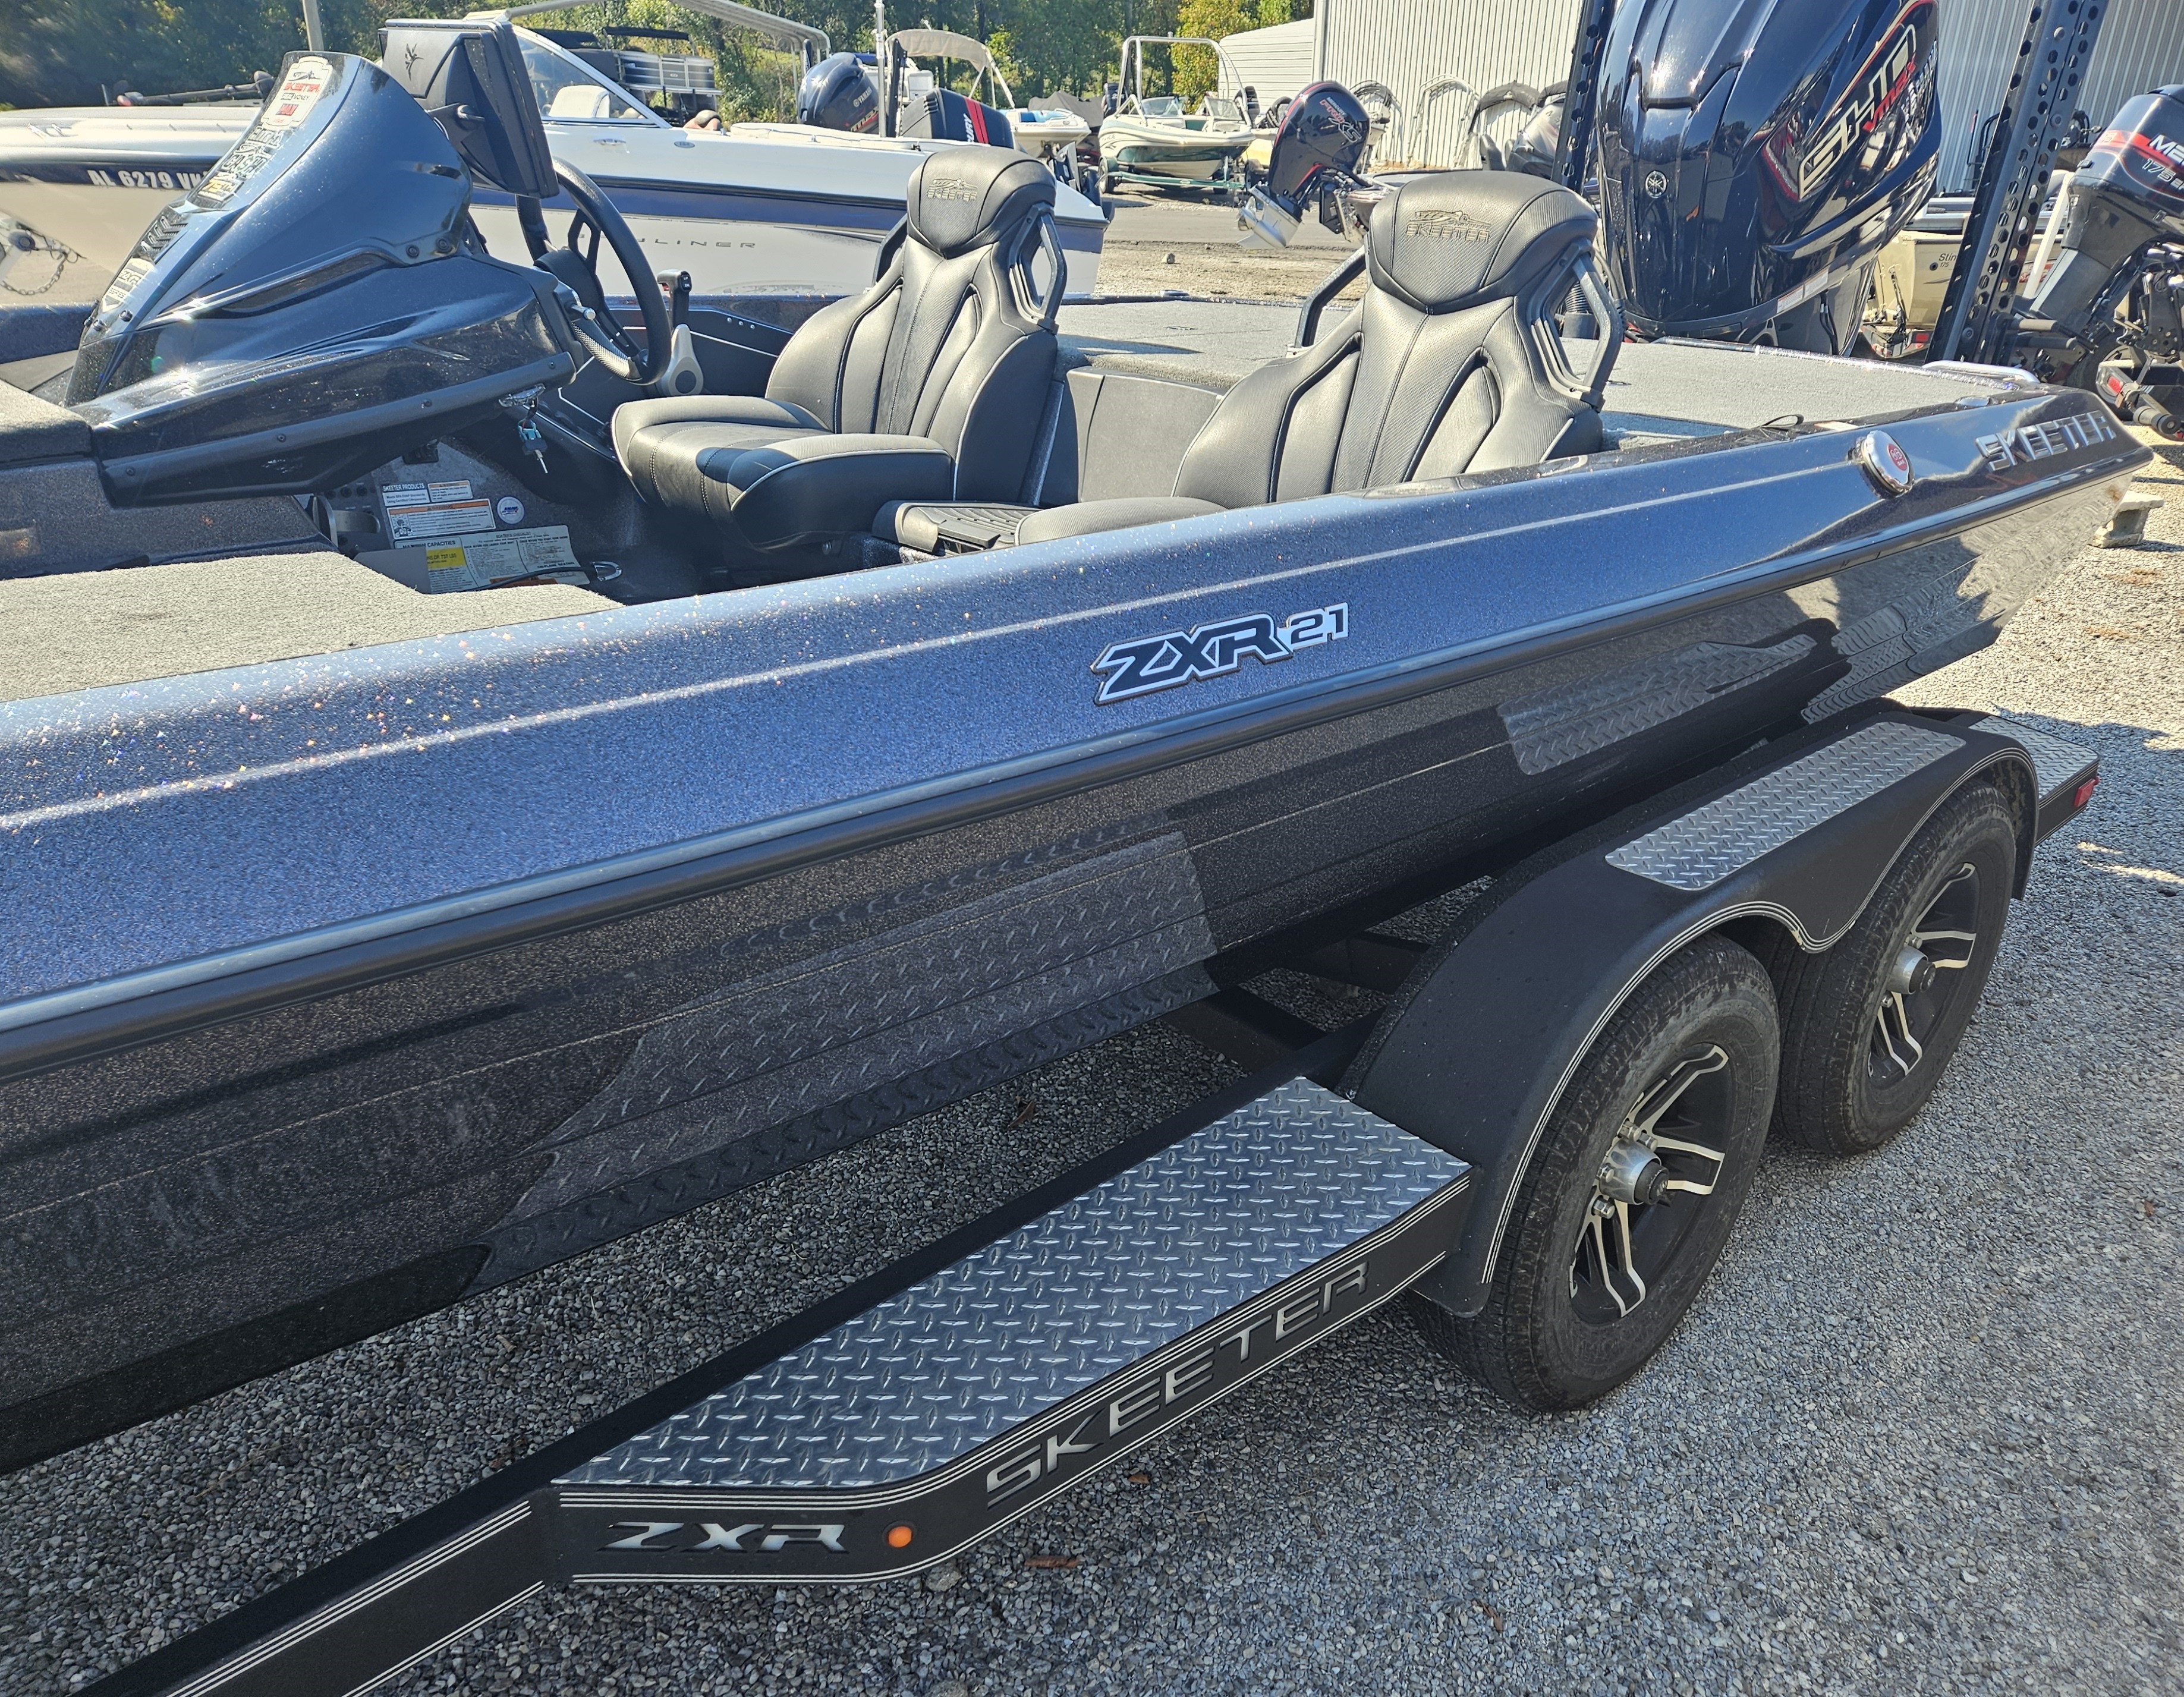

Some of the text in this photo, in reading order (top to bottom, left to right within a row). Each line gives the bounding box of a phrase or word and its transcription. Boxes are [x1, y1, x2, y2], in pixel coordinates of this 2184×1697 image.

[87, 169, 116, 187] AL
[118, 170, 174, 189] 6279
[2142, 158, 2176, 182] 175
[927, 188, 977, 202] SKEETER
[1406, 223, 1490, 242] SKEETER
[1975, 410, 2116, 472] SKEETER
[1095, 602, 1348, 703] ZXR 21
[984, 1260, 1371, 1510] SKEETER
[606, 1520, 847, 1554] ZXR
